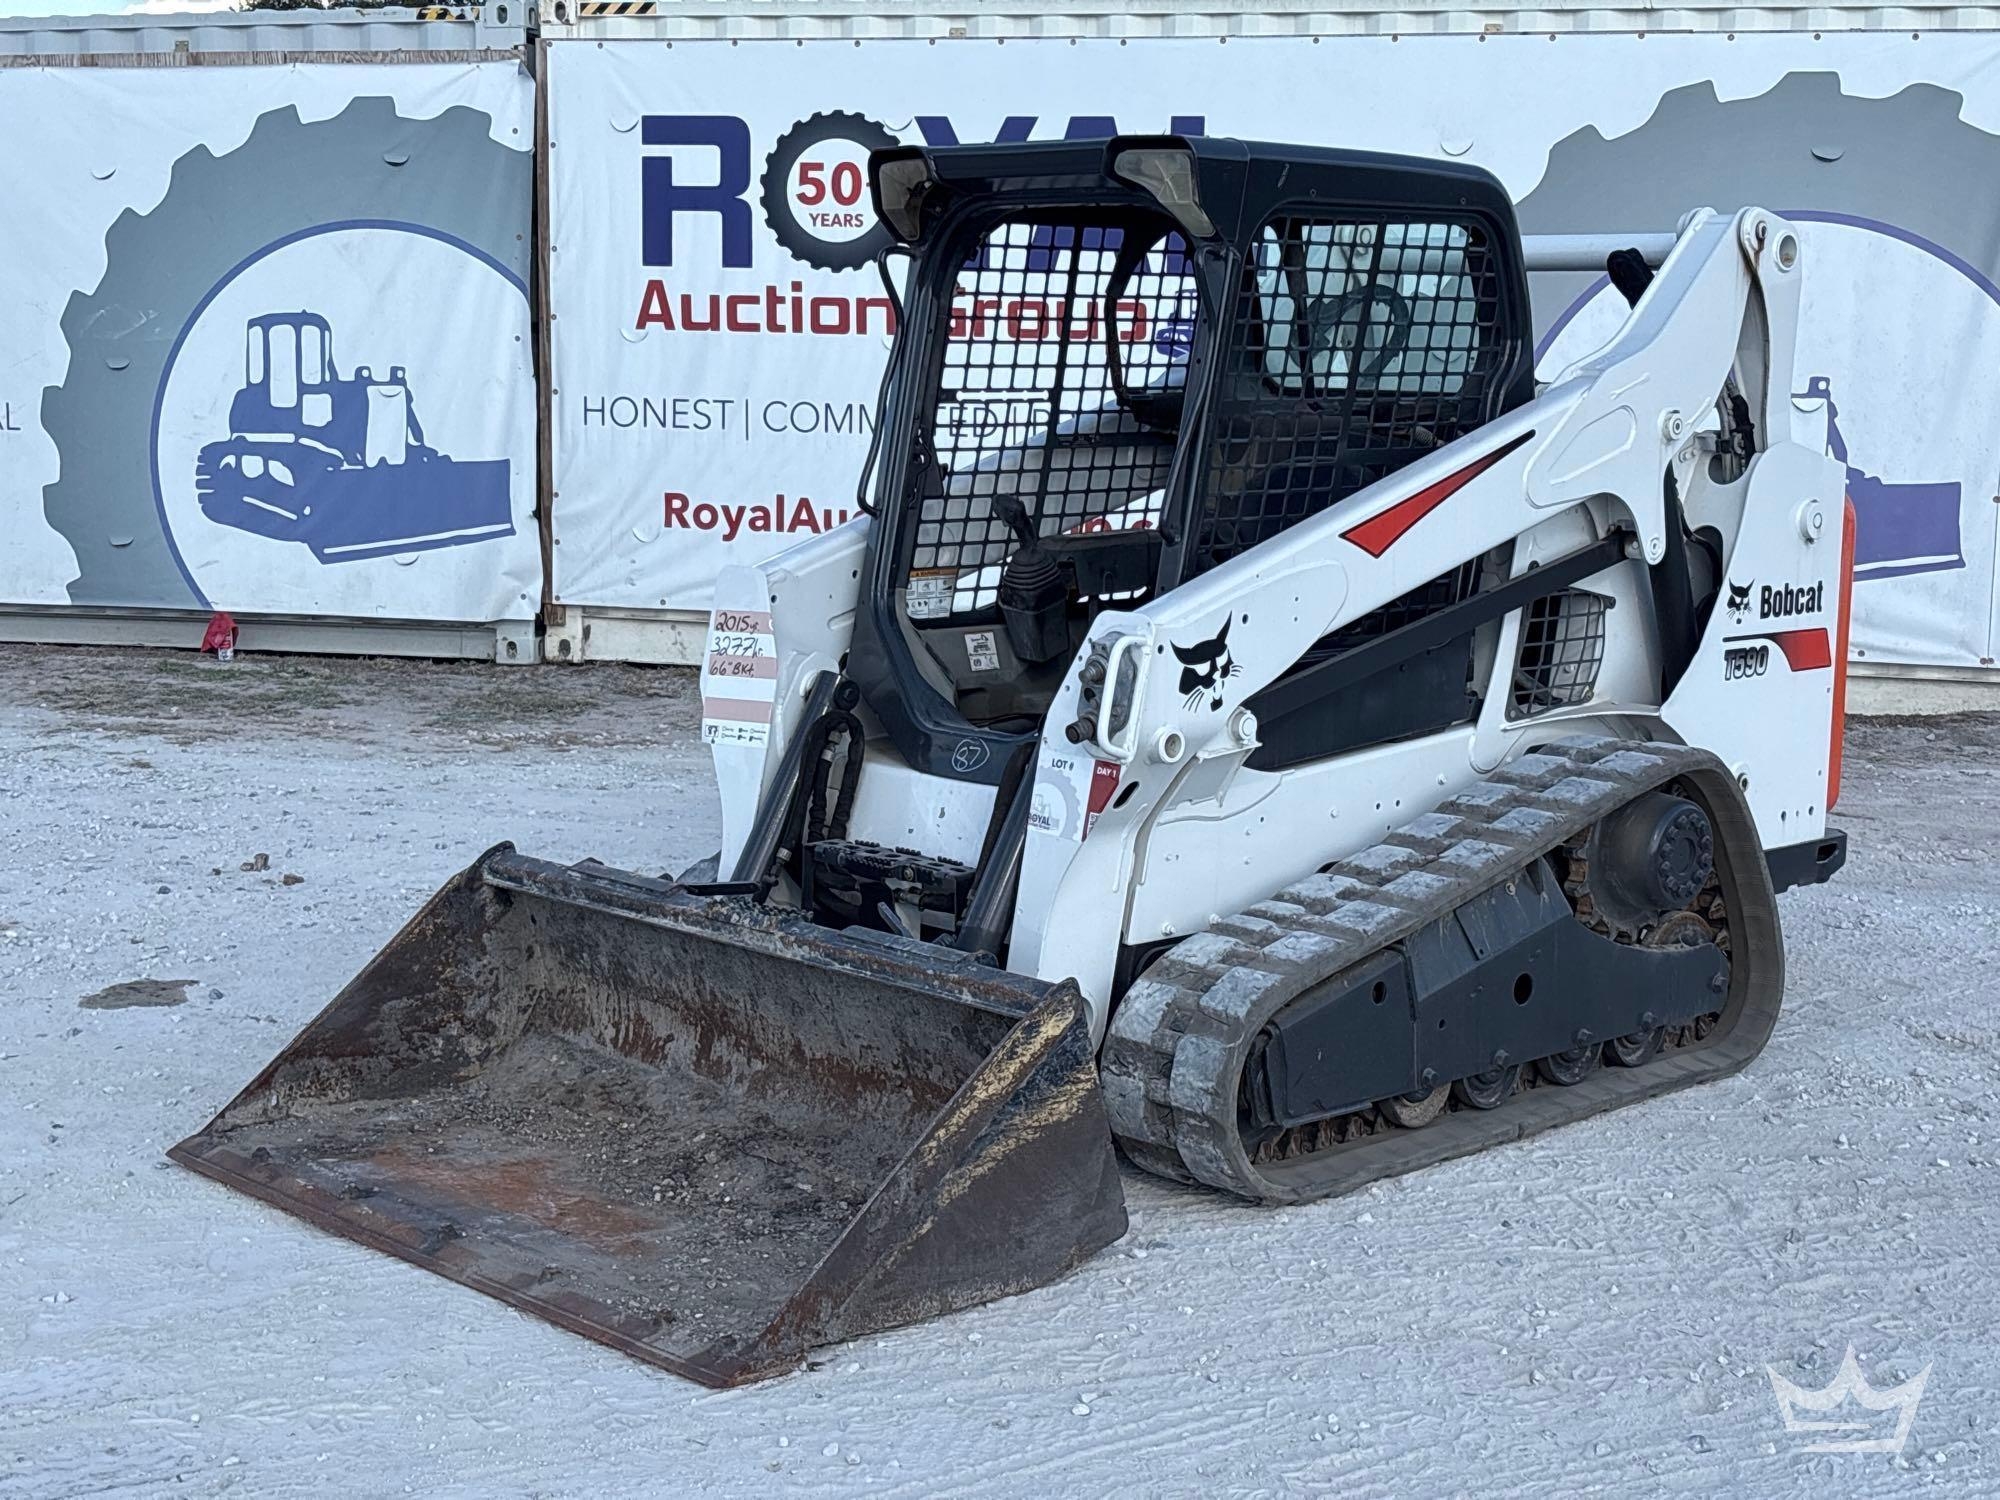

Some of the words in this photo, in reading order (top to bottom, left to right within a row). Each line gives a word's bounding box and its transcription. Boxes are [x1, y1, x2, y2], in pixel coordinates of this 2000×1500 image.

[808, 212, 864, 229] YEARS
[635, 279, 897, 336] Auction
[583, 395, 735, 431] HONEST
[1760, 580, 1824, 619] Bobcat
[1724, 645, 1769, 681] T590
[955, 745, 982, 771] 87
[1052, 758, 1068, 770] LOT
[1097, 767, 1111, 776] DAY
